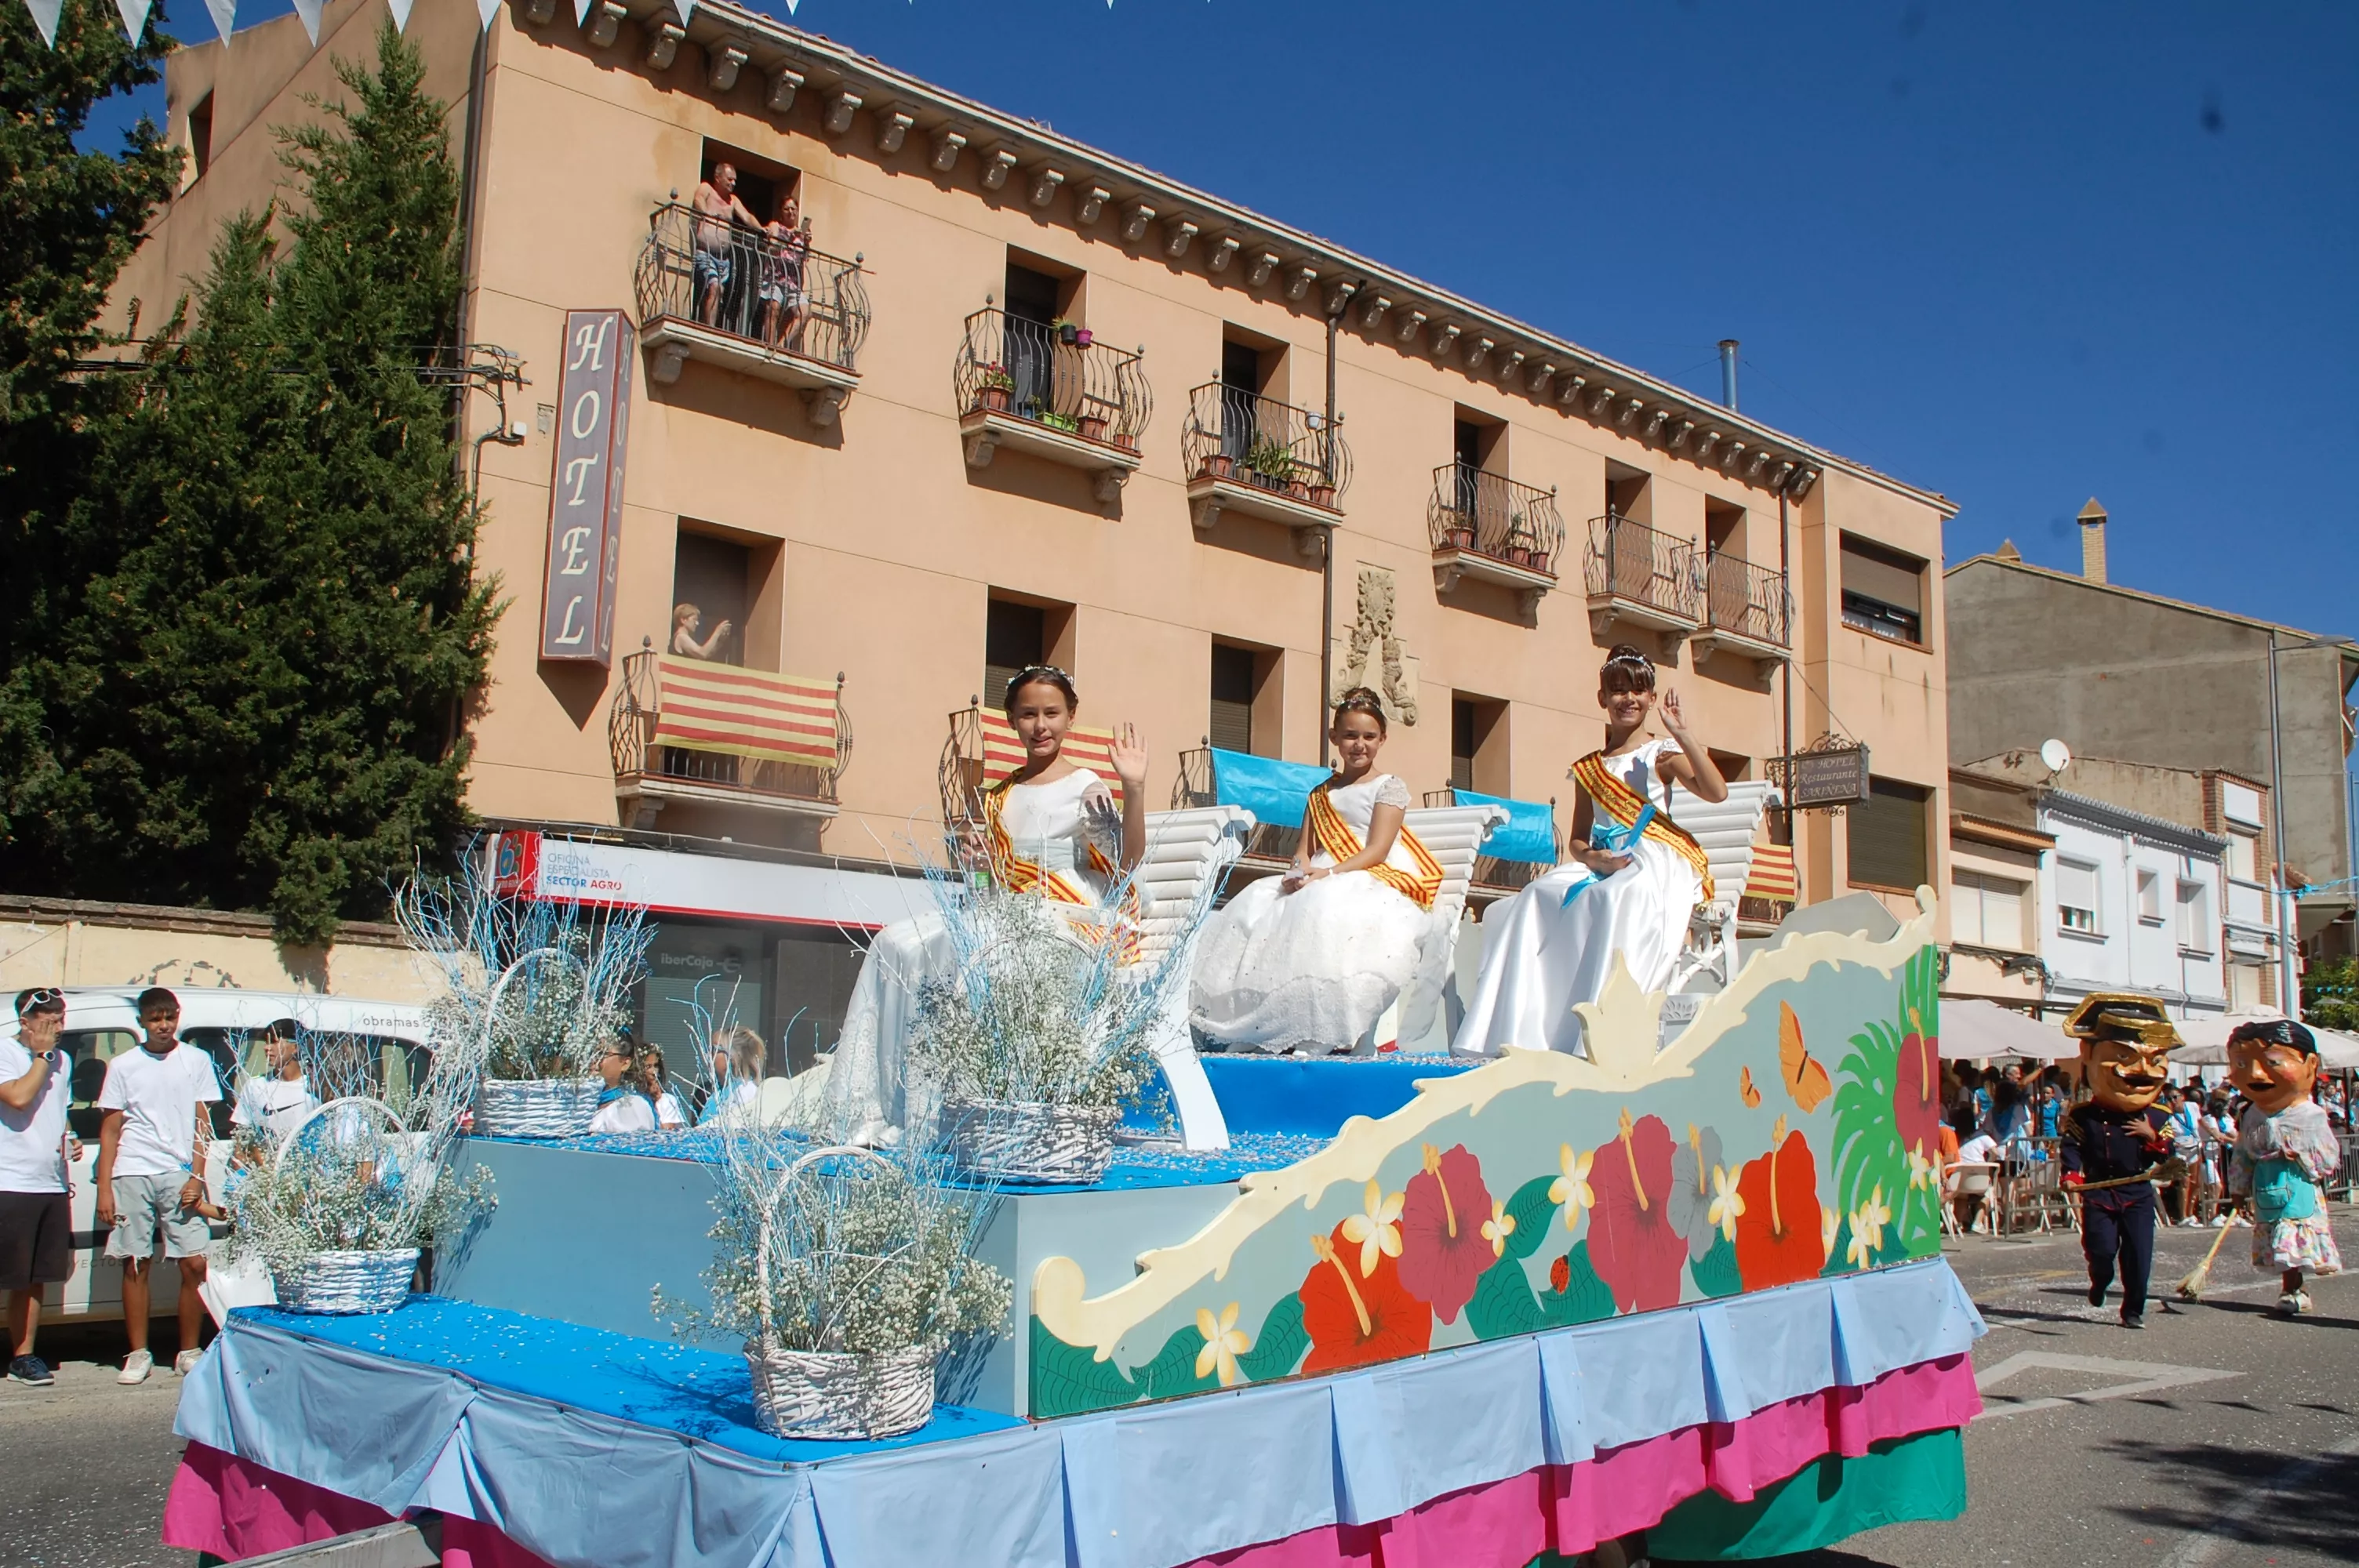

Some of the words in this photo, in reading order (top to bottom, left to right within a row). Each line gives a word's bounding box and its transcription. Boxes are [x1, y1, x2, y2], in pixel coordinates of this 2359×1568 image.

[554, 316, 614, 644] HOTEL
[601, 332, 634, 653] HOTEL
[1818, 756, 1856, 769] HOTEL
[1800, 770, 1857, 785] Restaurante
[1801, 782, 1856, 798] SARIÑENA
[547, 853, 591, 866] OFICINA
[547, 864, 610, 879] ESPECIALISTA
[547, 876, 587, 887] SECTOR
[591, 880, 622, 891] AGRO
